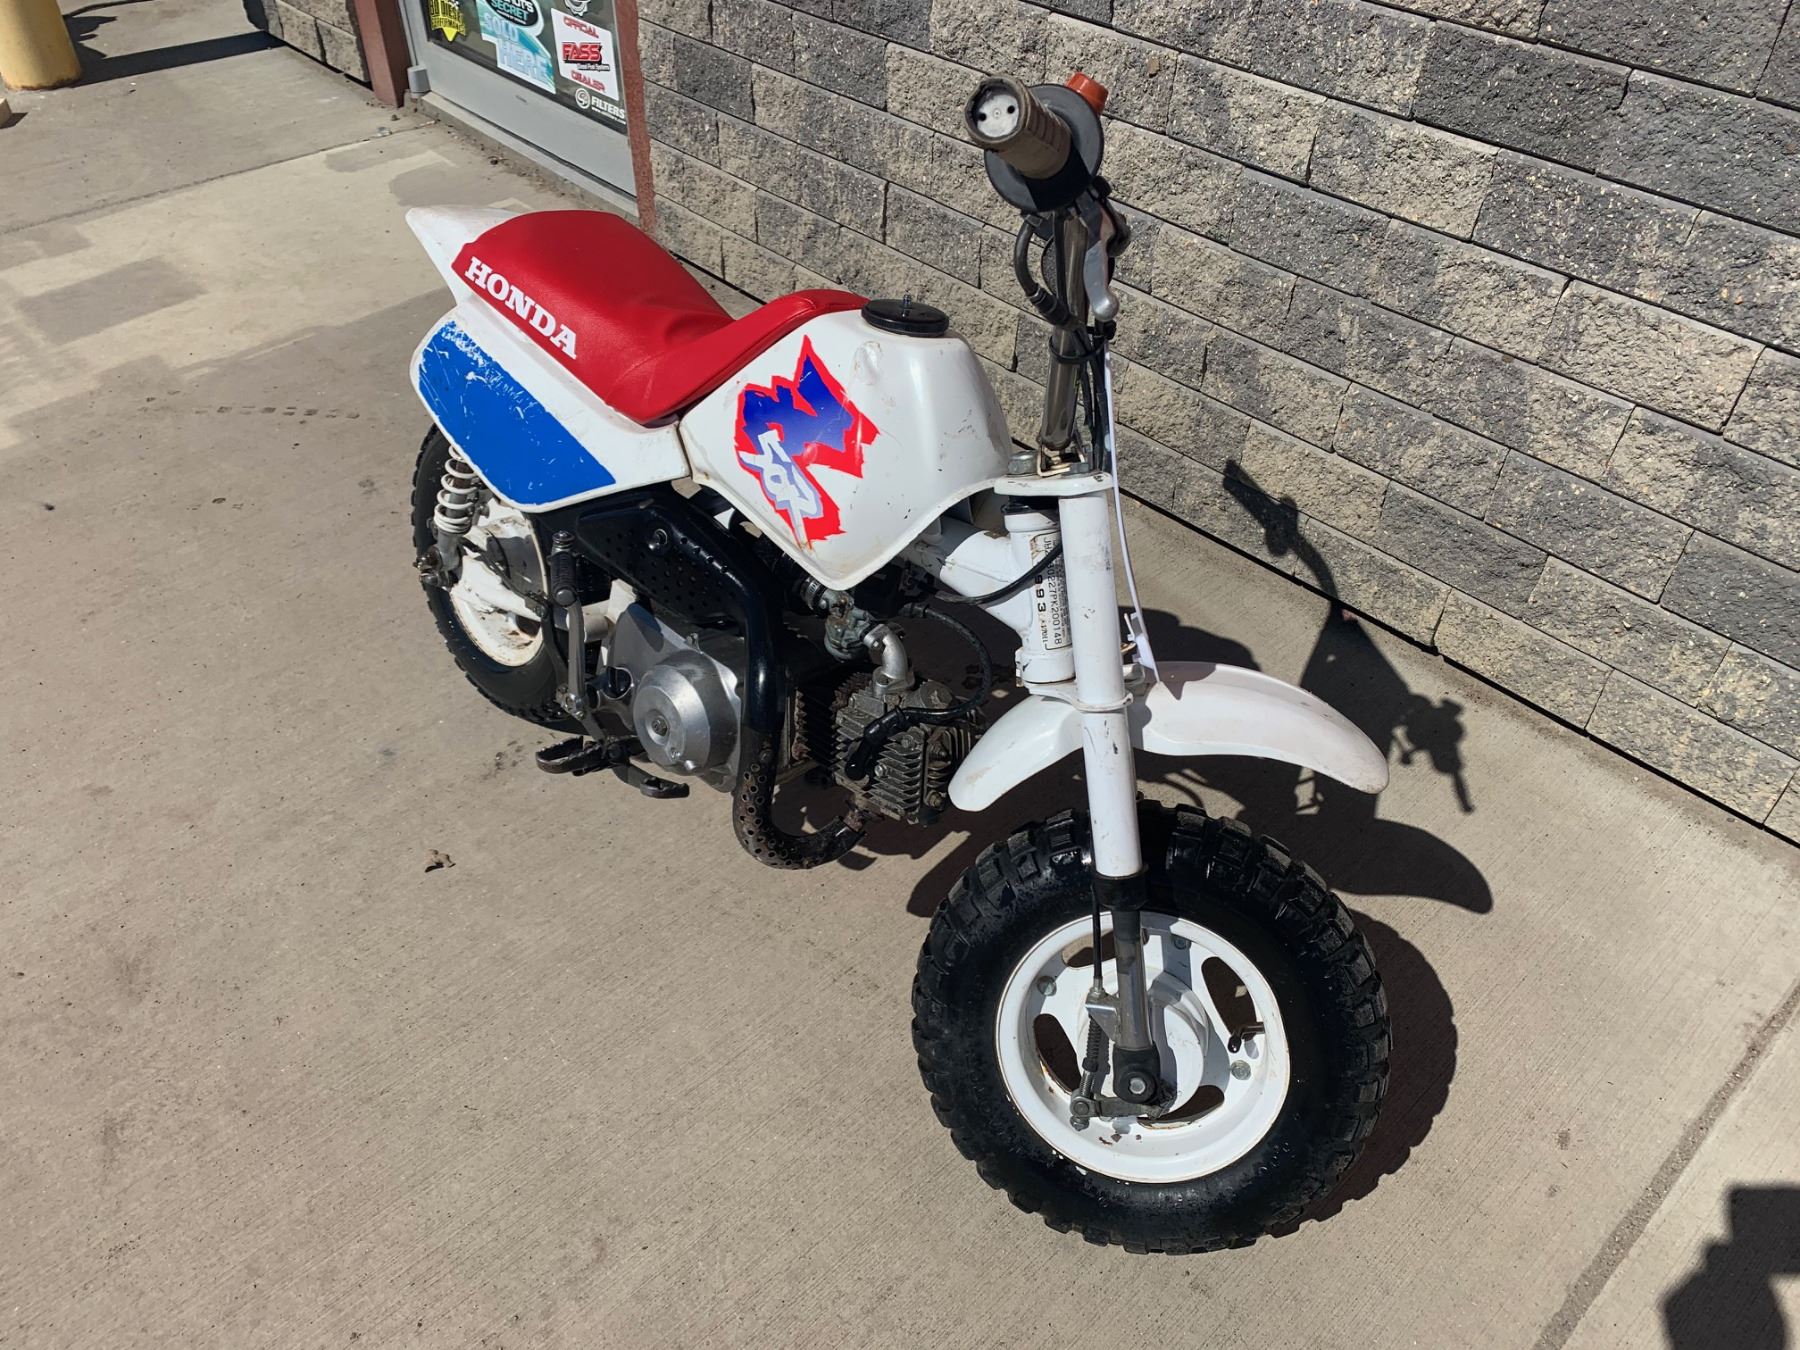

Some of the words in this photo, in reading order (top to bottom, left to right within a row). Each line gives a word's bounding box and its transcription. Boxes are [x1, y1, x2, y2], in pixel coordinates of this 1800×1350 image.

[491, 0, 530, 20] SECRET
[483, 12, 519, 42] SOLD
[499, 38, 549, 83] HERE
[562, 42, 602, 63] FASS
[591, 96, 625, 119] FILTERS
[464, 256, 577, 360] HONDA
